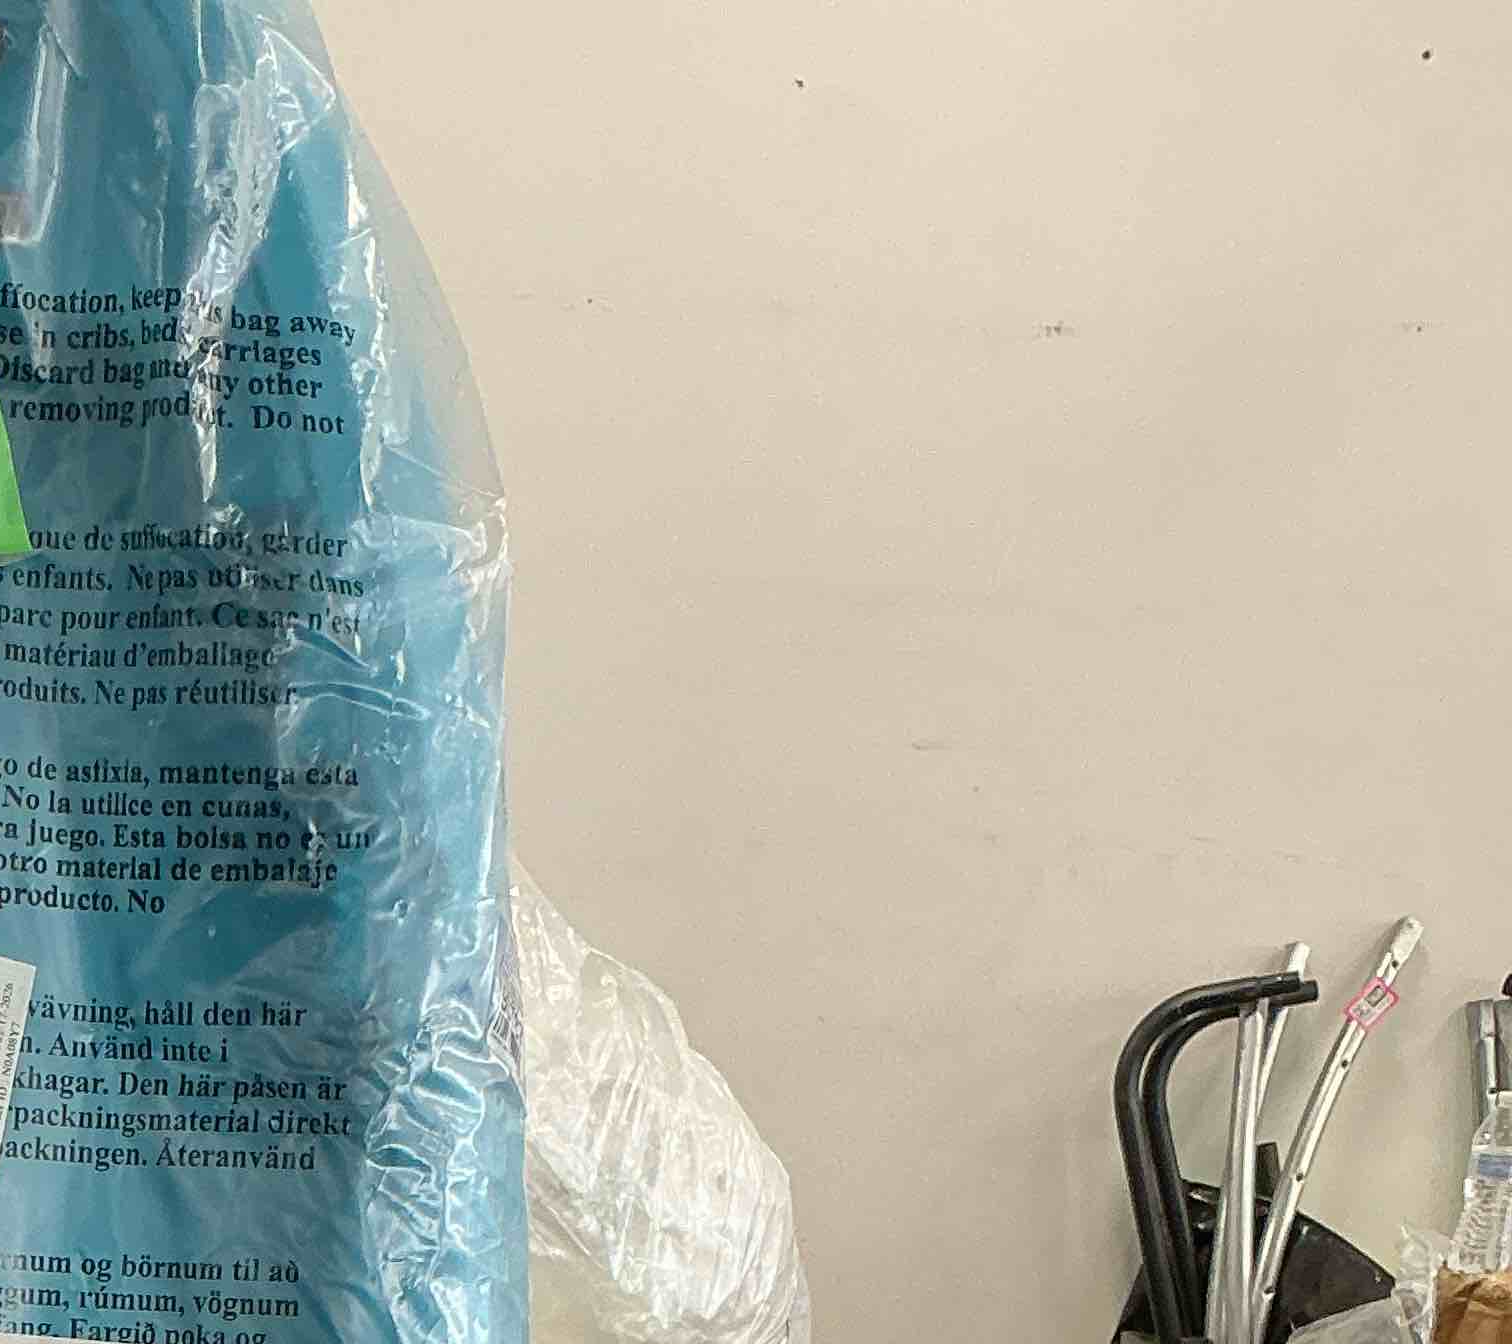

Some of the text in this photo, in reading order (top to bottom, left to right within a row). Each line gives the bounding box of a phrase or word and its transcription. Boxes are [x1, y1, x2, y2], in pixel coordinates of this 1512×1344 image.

[290, 316, 356, 345] away
[9, 399, 344, 434] removing Do not
[96, 680, 126, 705] Ne
[132, 684, 166, 710] pas
[28, 755, 57, 779] de
[2, 784, 39, 809] No
[26, 819, 105, 850] juego.
[144, 1000, 306, 1027] håll den här
[49, 1033, 211, 1063] Använd inte
[120, 1072, 168, 1097] Den
[268, 1108, 351, 1136] direkt
[156, 1138, 315, 1171] Återanvänd
[122, 1254, 222, 1281] börnum
[192, 1293, 298, 1321] vögnum
